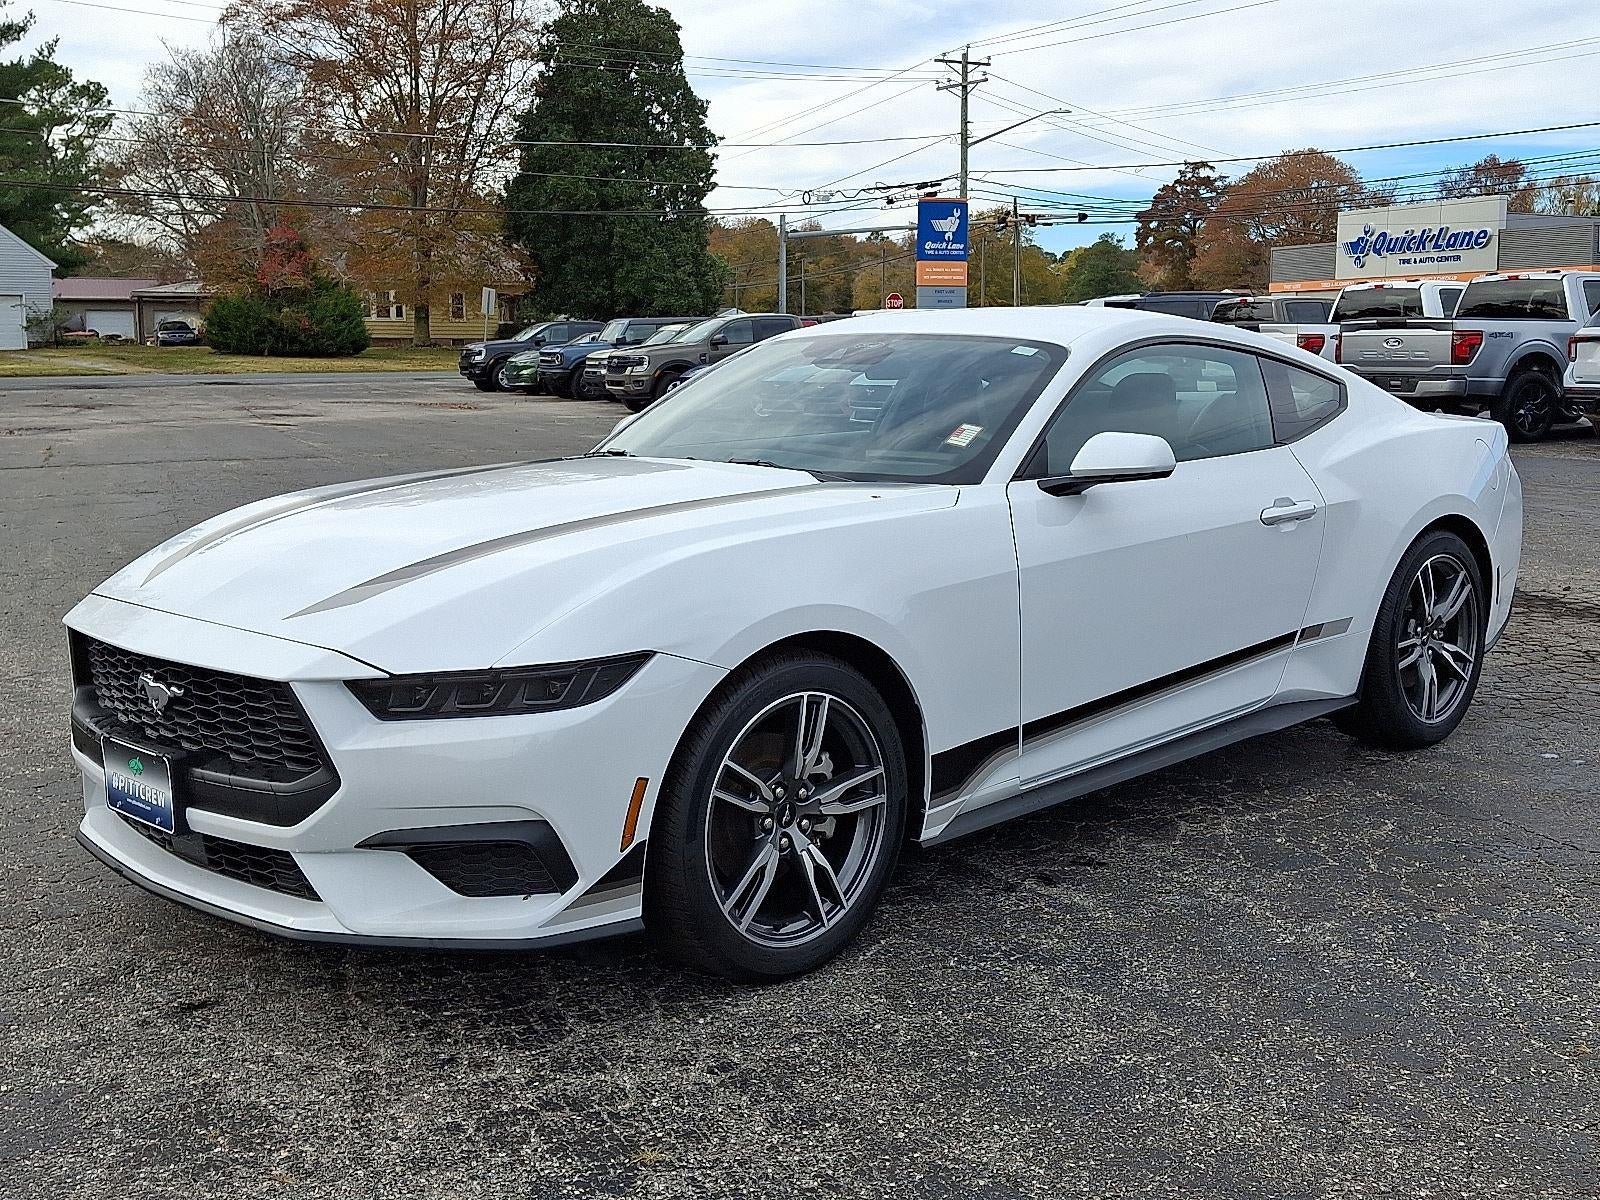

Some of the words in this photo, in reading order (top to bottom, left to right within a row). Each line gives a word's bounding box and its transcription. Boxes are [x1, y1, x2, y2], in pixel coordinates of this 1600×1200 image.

[924, 241, 947, 250] Quick
[947, 242, 965, 250] Lane
[1372, 226, 1428, 257] Quick
[1431, 226, 1489, 250] Lane
[1418, 256, 1436, 264] AUTO
[1436, 254, 1462, 263] CENTER
[887, 299, 902, 308] STOP
[1359, 350, 1430, 360] F-150
[112, 771, 166, 809] #PITTCREW
